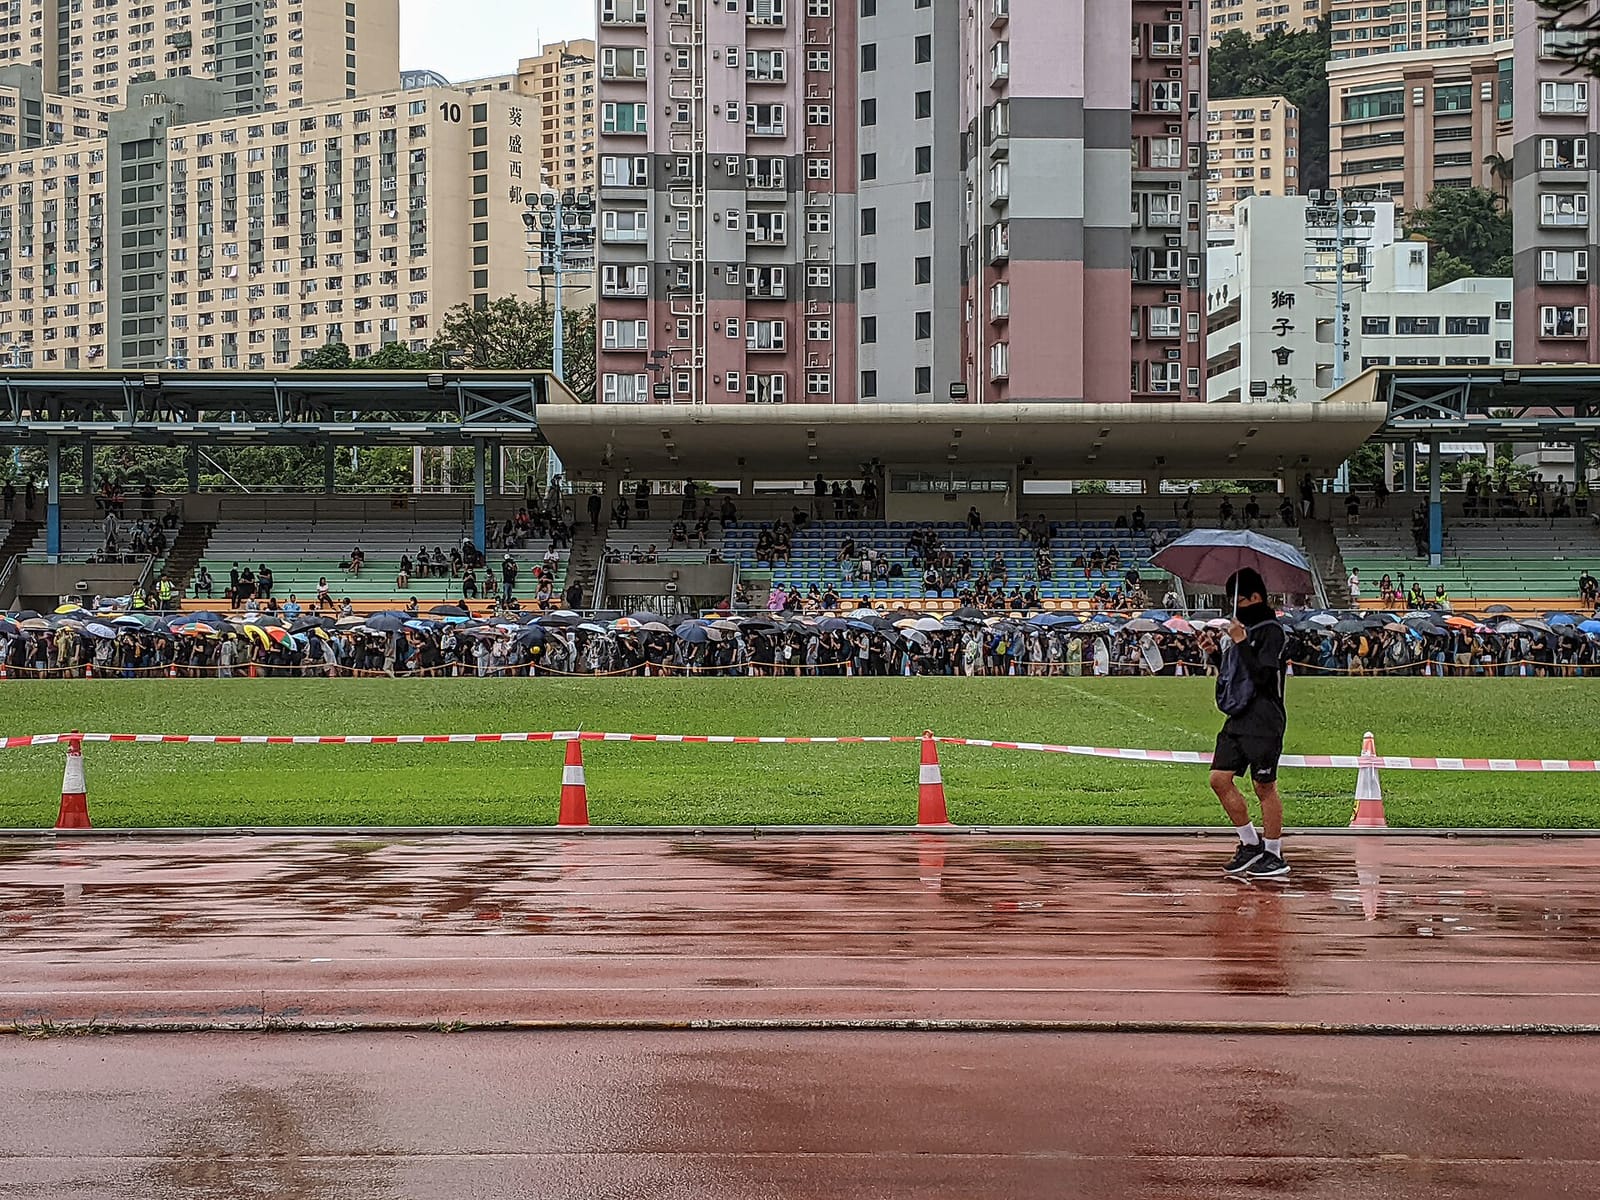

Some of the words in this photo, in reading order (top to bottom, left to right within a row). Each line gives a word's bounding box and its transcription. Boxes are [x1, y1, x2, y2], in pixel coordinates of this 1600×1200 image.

[439, 101, 461, 123] 10
[1272, 100, 1280, 110] 7
[508, 106, 523, 205] 葵盛西邨
